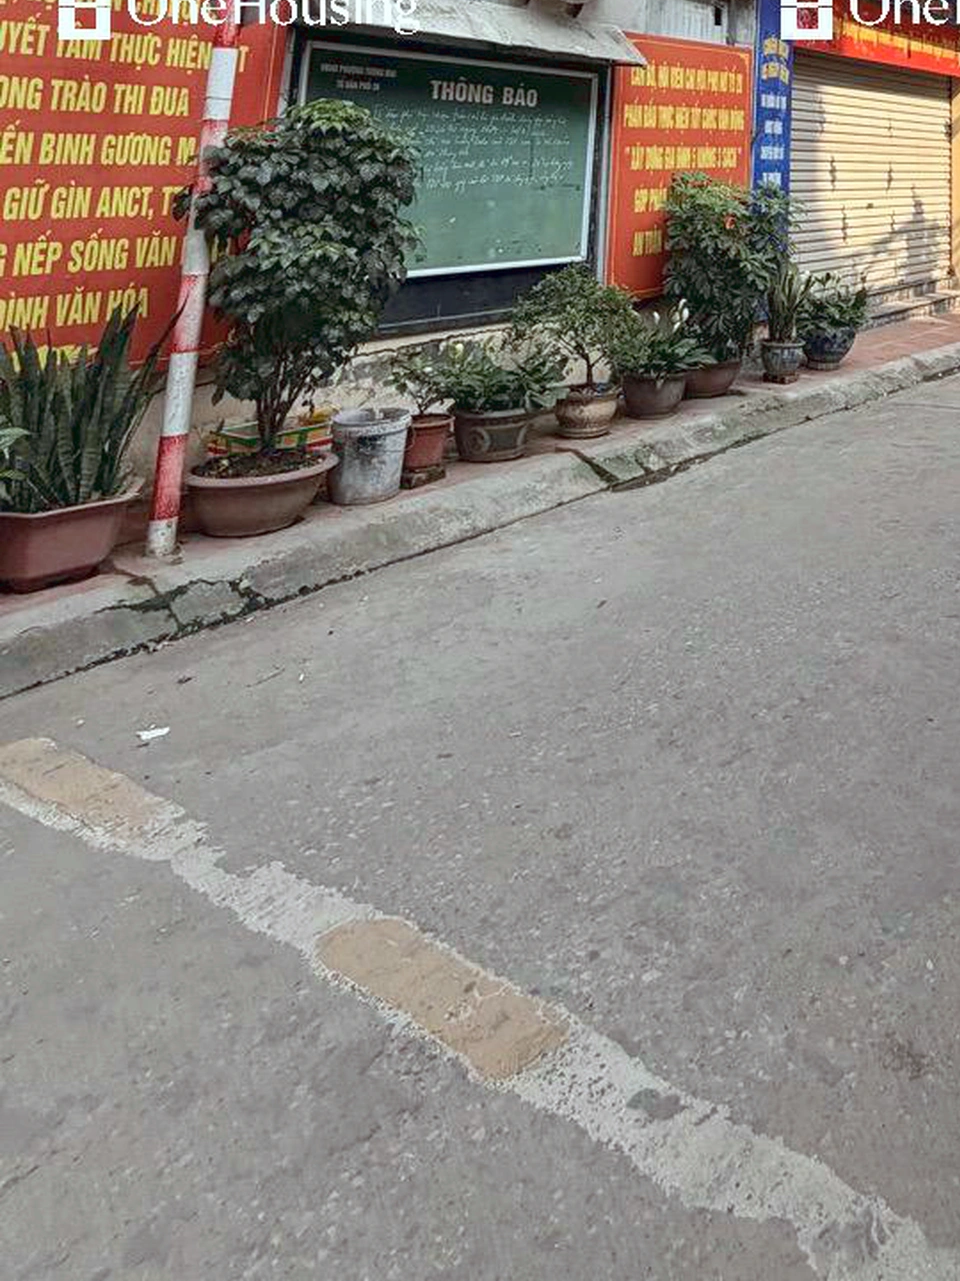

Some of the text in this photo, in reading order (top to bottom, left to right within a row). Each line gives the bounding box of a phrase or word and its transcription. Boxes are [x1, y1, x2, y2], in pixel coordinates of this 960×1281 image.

[109, 31, 160, 71] THỰC
[165, 34, 213, 75] HIỆN
[50, 74, 107, 114] TRÀO
[113, 83, 146, 116] THI
[150, 85, 190, 117] ĐUA
[430, 76, 538, 108] THÔNG BÁO
[38, 131, 96, 166] BINH
[101, 131, 171, 167] GƯƠNG
[3, 178, 50, 221] GIỮ
[51, 179, 91, 220] GÌN
[96, 185, 154, 221] ANCT,
[13, 230, 62, 277] NẾP
[67, 227, 129, 274] SỐNG
[135, 230, 176, 269] VĂN
[55, 286, 101, 327] VĂN
[106, 282, 148, 321] HÓA
